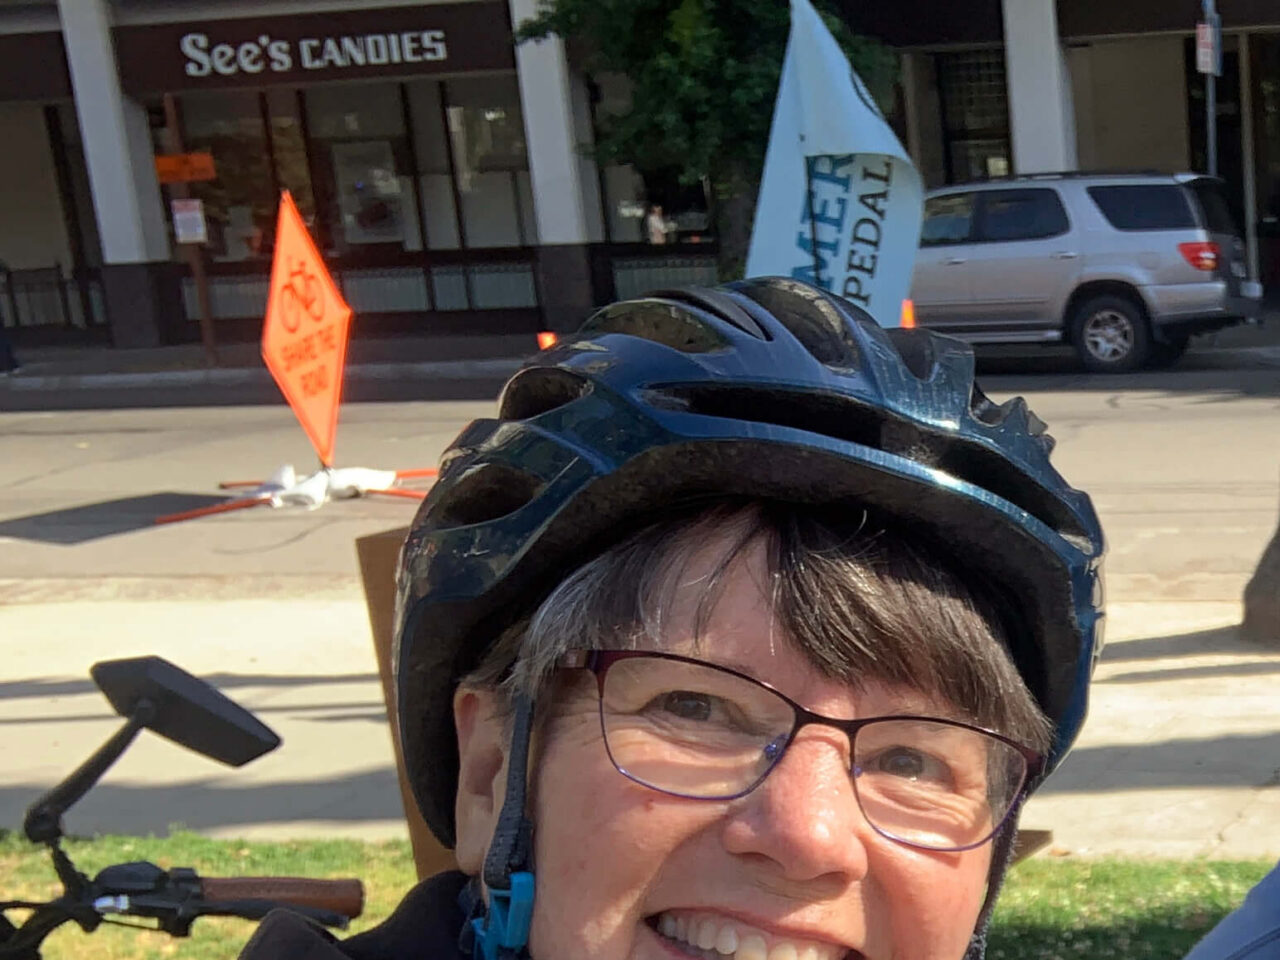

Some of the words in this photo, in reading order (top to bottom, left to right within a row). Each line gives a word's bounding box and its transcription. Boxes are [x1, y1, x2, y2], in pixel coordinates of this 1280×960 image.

[180, 33, 293, 77] See's
[299, 30, 448, 69] CANDIES
[842, 156, 894, 307] PEDAL
